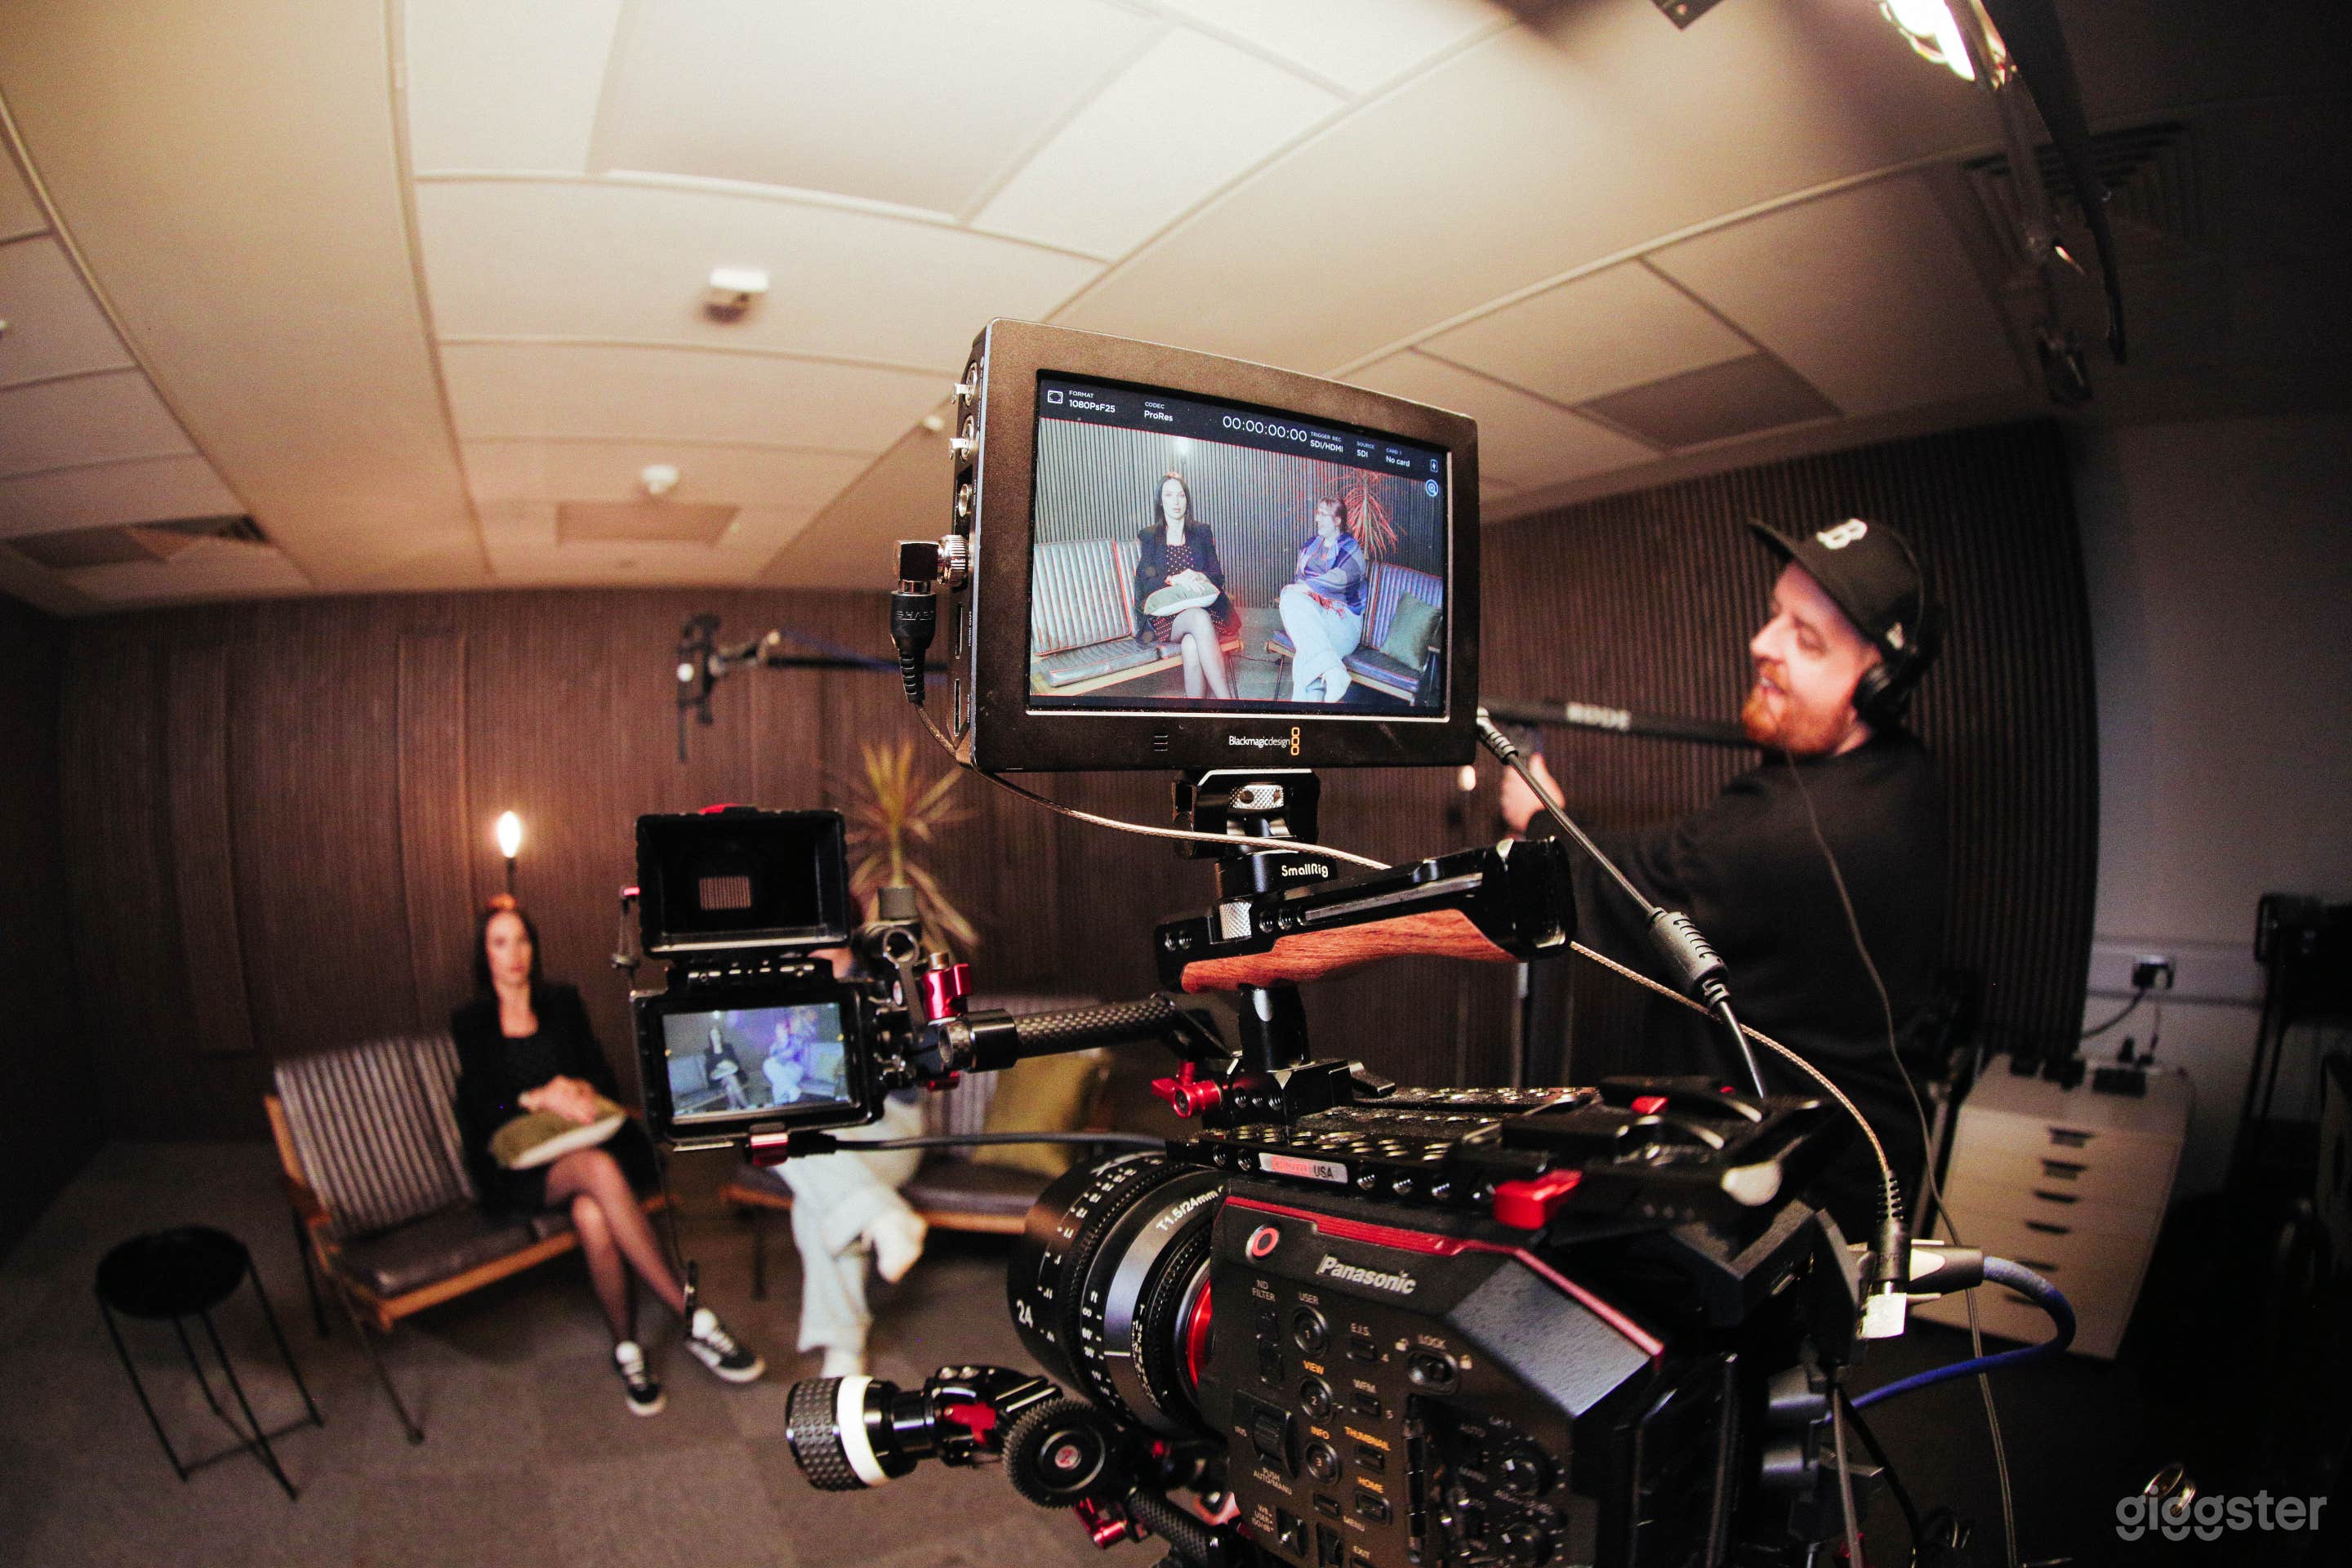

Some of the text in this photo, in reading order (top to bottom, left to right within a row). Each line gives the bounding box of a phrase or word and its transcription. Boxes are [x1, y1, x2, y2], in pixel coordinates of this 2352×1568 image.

[1069, 390, 1094, 399] FORMAT
[1068, 399, 1116, 413] 1080PsF25
[1144, 401, 1165, 409] CODEC
[1144, 410, 1173, 422] ProRes
[1223, 416, 1307, 442] 00:00:00:00
[1310, 439, 1343, 453] SDI/HDMI
[1356, 449, 1368, 457] SDI
[1386, 455, 1410, 467] No card
[1281, 863, 1329, 878] SmallRig
[1313, 1165, 1334, 1179] USA
[1315, 1254, 1416, 1294] Panasonic
[1257, 1280, 1269, 1290] ND
[1252, 1287, 1276, 1302] FILTER
[1298, 1292, 1320, 1305] USER
[1017, 1299, 1033, 1329] 24
[1303, 1360, 1325, 1375] VIEW
[1312, 1396, 1317, 1405] 2
[1311, 1426, 1330, 1440] INFO
[1263, 1467, 1281, 1481] PUSH
[1357, 1476, 1384, 1494] HOME
[1343, 1515, 1365, 1532] MENU
[1353, 1545, 1370, 1559] EXIT
